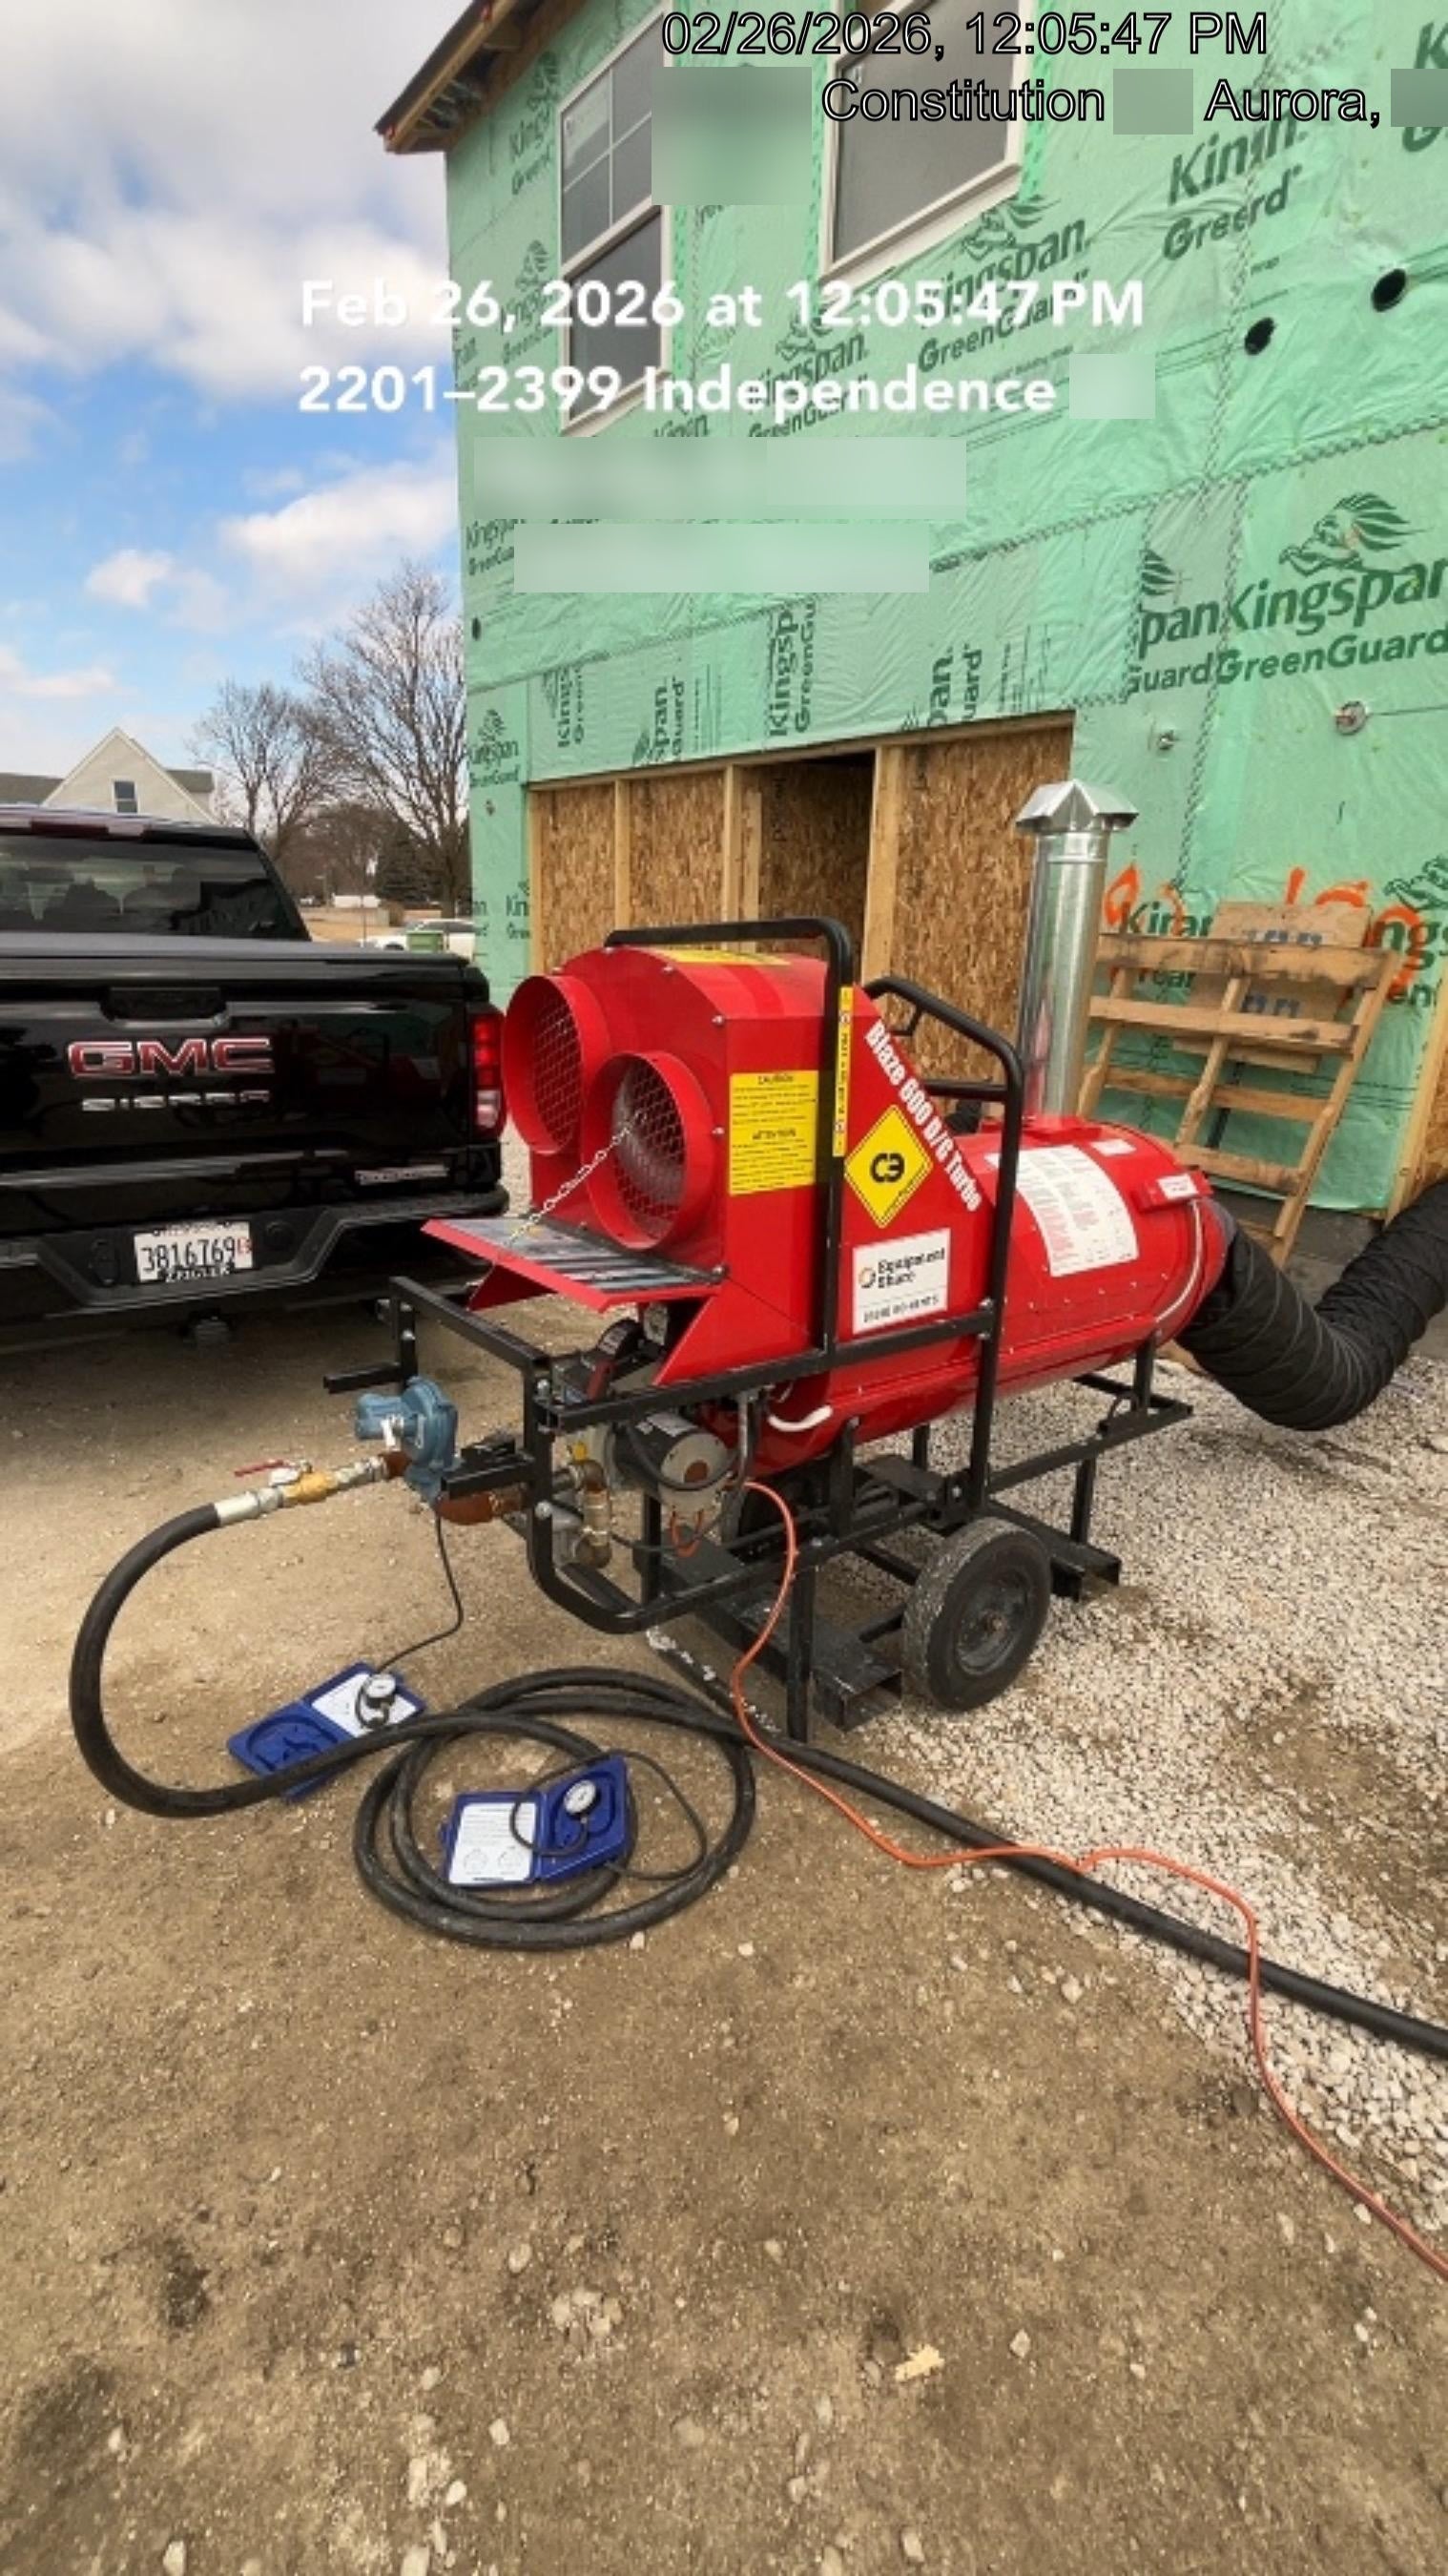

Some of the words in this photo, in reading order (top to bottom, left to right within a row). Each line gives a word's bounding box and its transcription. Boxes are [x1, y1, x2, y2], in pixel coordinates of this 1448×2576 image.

[68, 1038, 275, 1079] GMC
[865, 1019, 906, 1086] Blaze
[140, 1236, 236, 1272] 3816769
